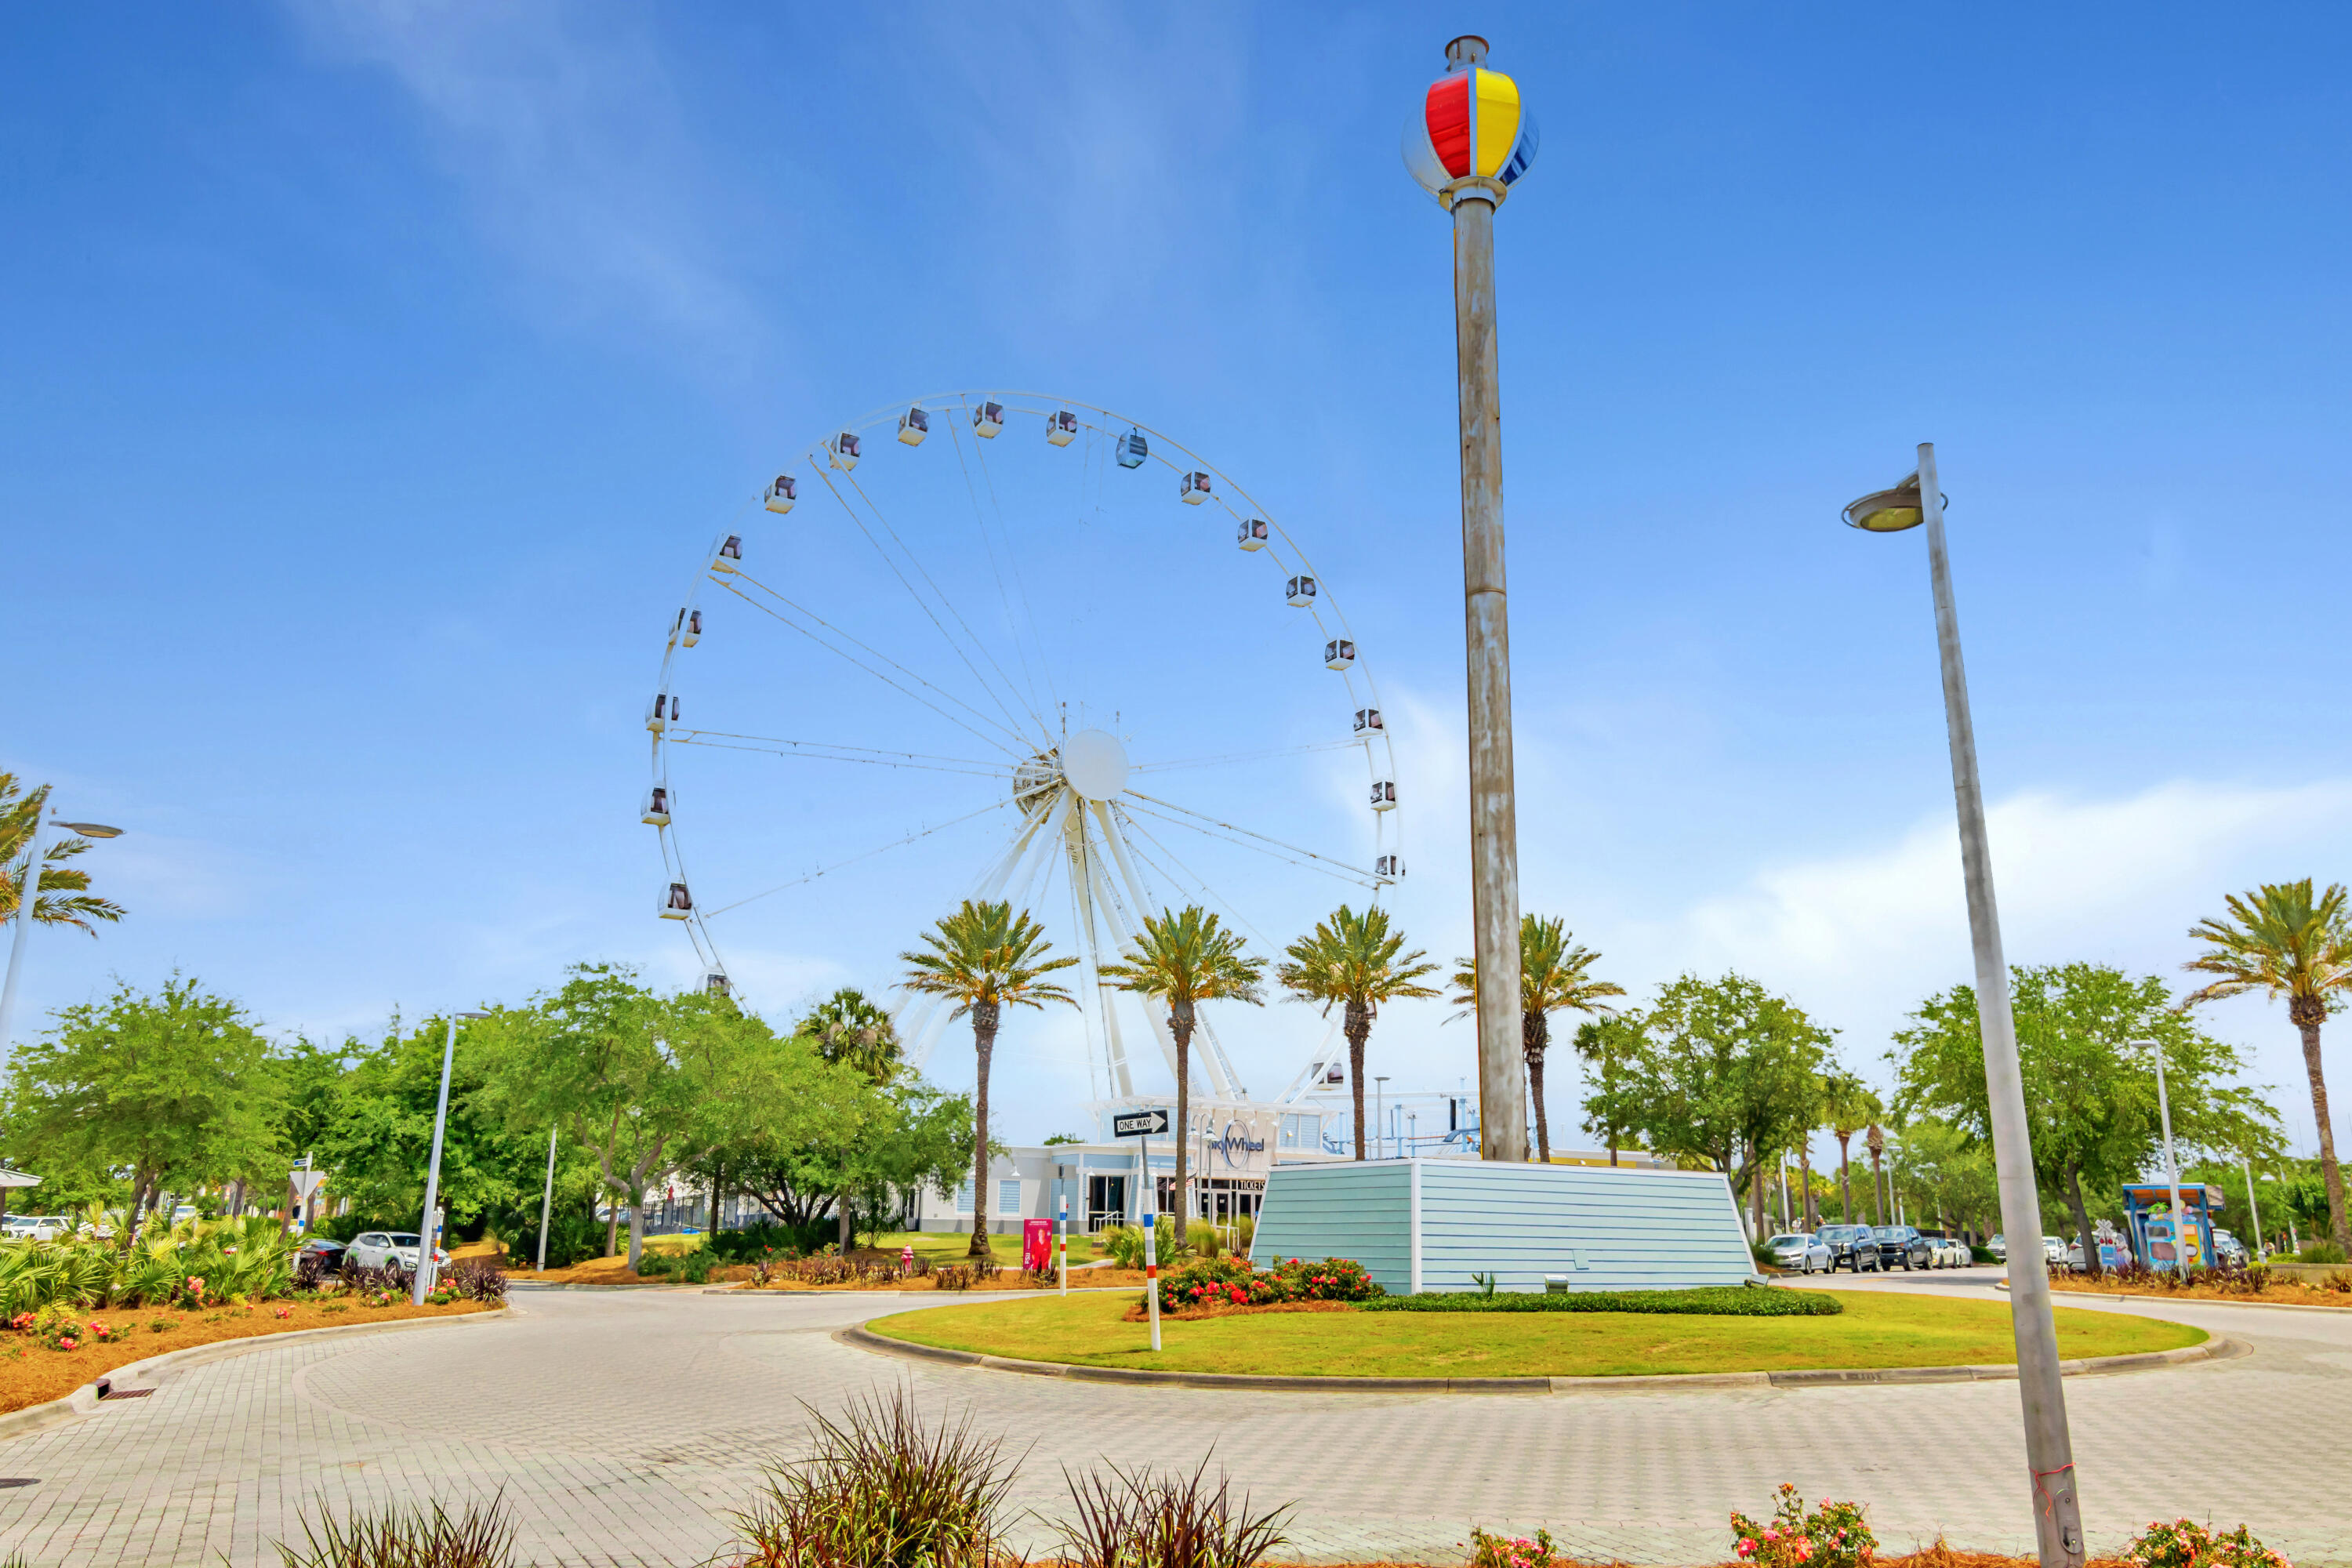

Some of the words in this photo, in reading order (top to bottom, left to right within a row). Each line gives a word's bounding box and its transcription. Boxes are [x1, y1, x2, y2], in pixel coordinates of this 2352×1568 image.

[1119, 1120, 1134, 1131] ONE
[1137, 1118, 1152, 1129] WAY
[1208, 1137, 1264, 1153] kyWheel
[1240, 1180, 1265, 1190] TICKETS
